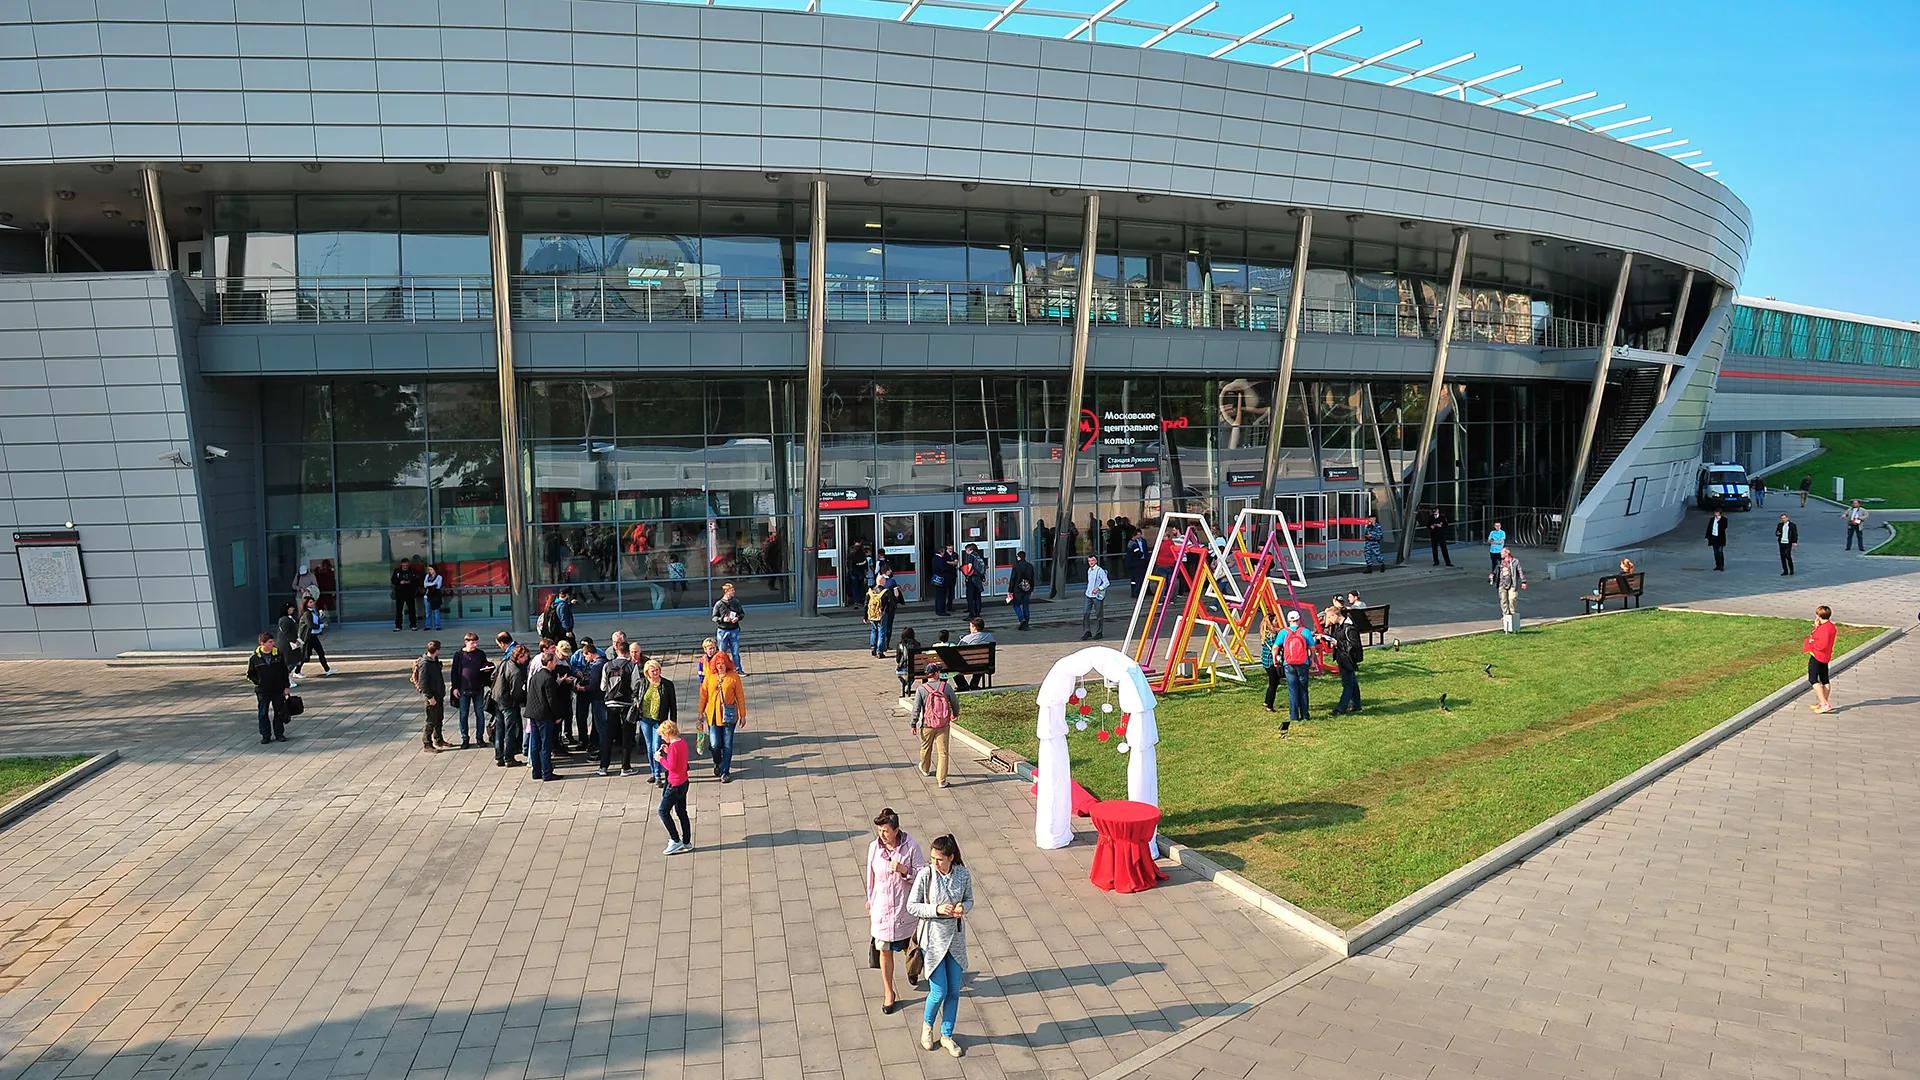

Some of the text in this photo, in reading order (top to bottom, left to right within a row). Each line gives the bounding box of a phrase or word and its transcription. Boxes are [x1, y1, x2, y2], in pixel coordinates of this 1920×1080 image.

[1104, 411, 1156, 420] Московское
[1104, 424, 1159, 434] центральное
[1104, 437, 1136, 446] кольцо
[1130, 456, 1155, 464] Лужники
